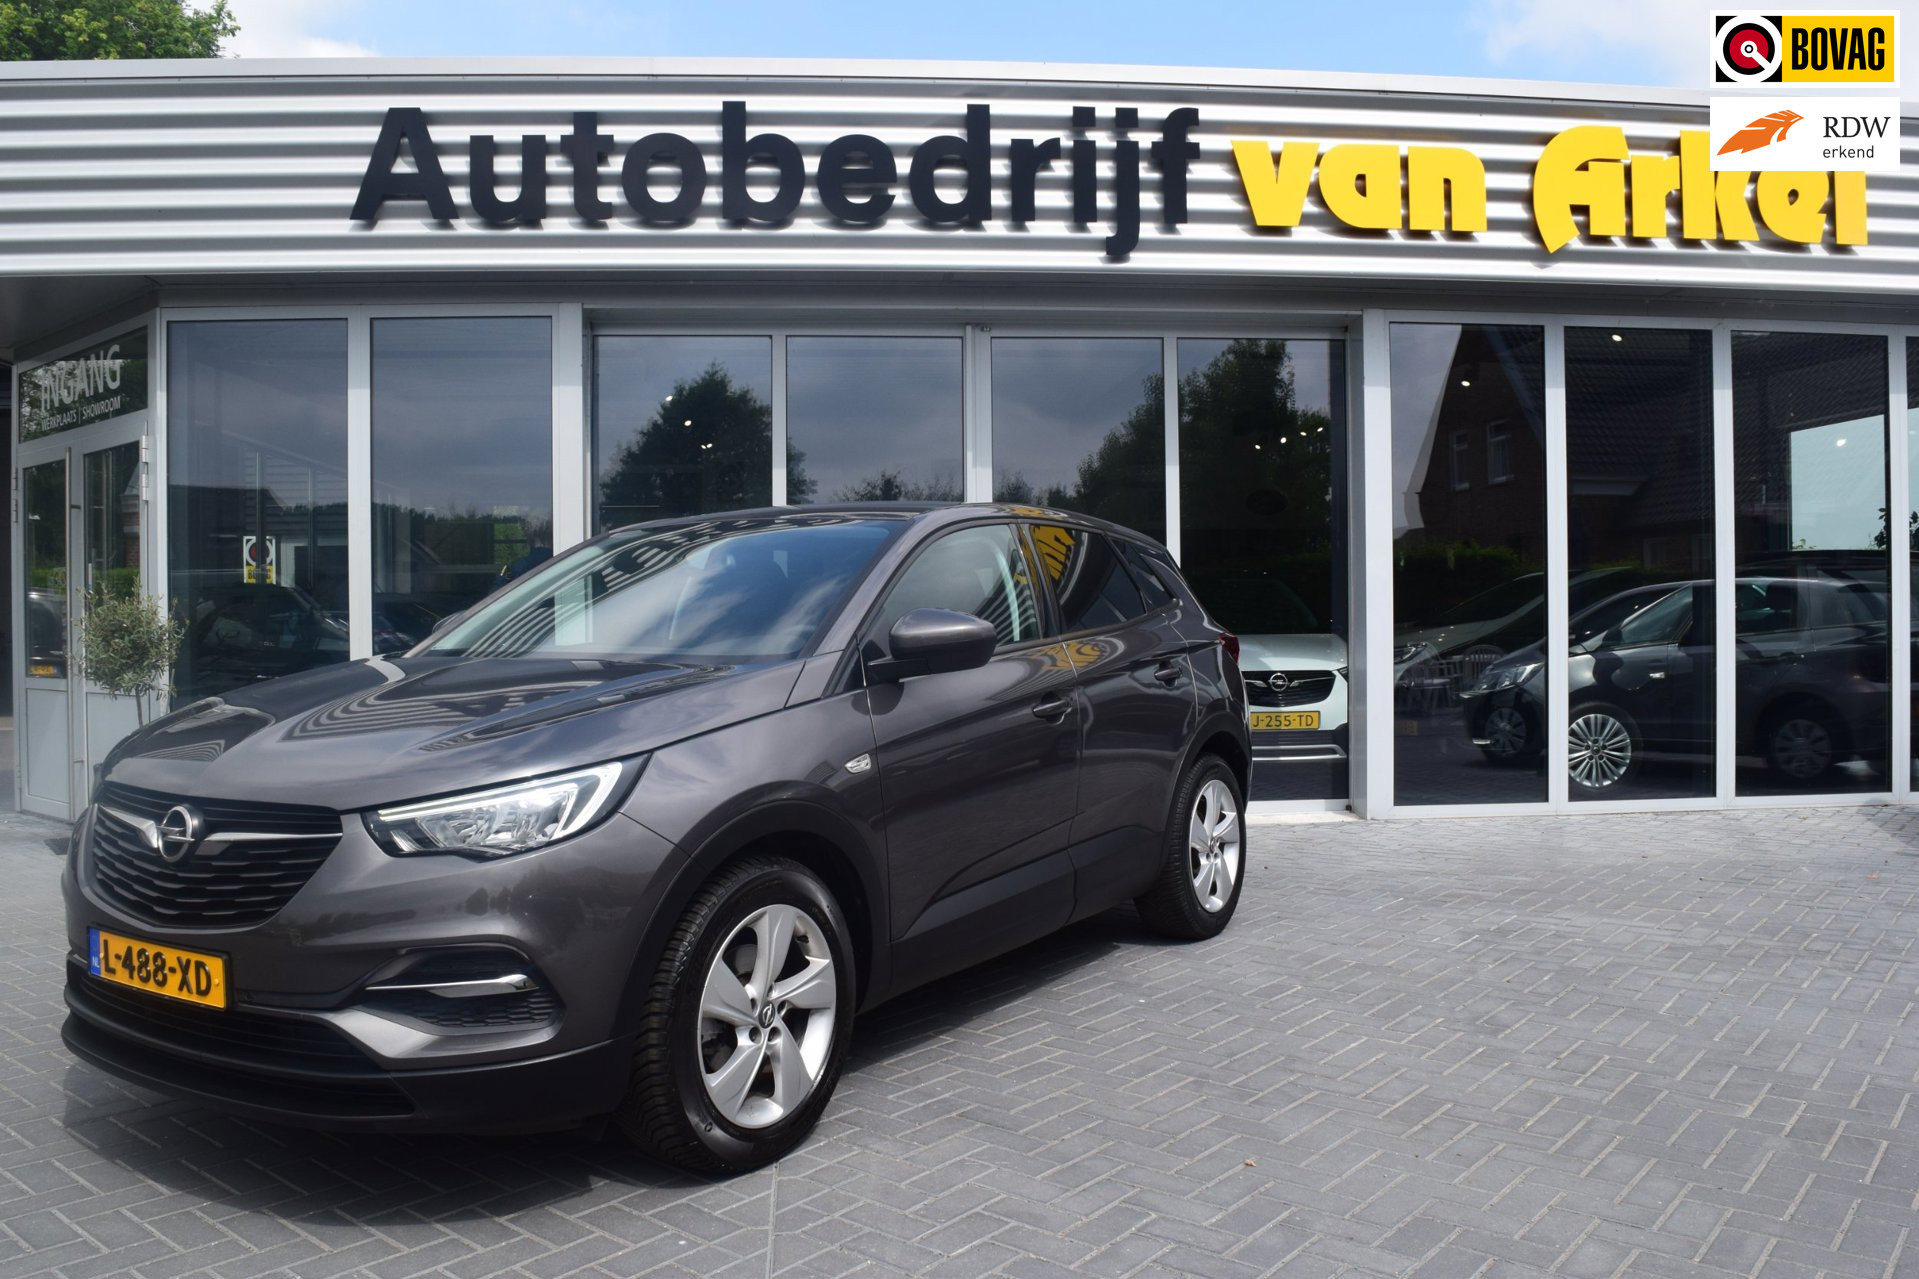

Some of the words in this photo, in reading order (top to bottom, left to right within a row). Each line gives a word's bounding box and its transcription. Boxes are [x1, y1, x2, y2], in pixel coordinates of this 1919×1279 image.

[349, 100, 1200, 256] Autobedrijf
[1230, 139, 1488, 232] van
[1533, 125, 1868, 254] Arkel
[41, 344, 121, 412] INGANG
[41, 409, 77, 431] WERKPLAATS
[82, 396, 121, 420] SHOWROOM
[1252, 714, 1314, 728] J-255-TD
[103, 938, 212, 997] L-488-XD
